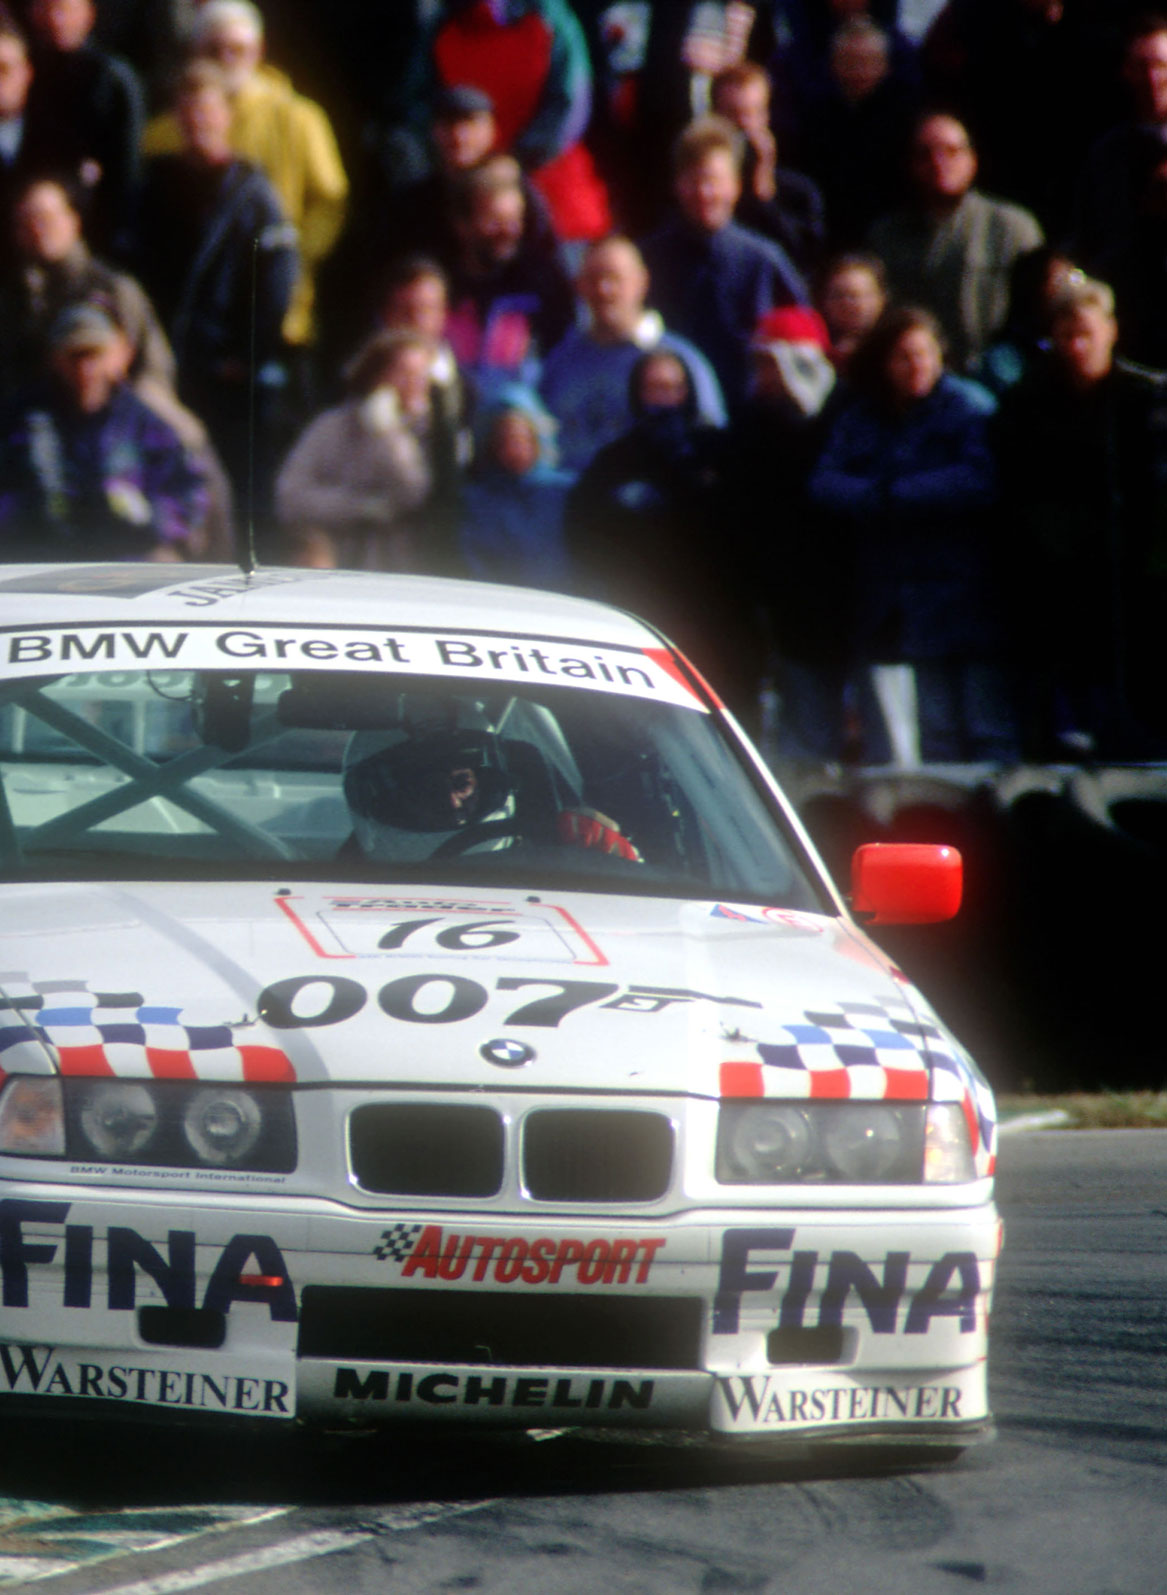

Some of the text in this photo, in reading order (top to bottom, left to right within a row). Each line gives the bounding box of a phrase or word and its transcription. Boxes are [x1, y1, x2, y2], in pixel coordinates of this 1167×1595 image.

[8, 630, 655, 689] BMW Great Britain
[377, 917, 521, 950] 16
[257, 974, 618, 1028] 007
[70, 1166, 287, 1184] BMW Motorsport International
[401, 1225, 666, 1285] AUTOSPORT
[713, 1228, 981, 1334] FINA
[334, 1368, 654, 1409] MICHELIN
[715, 1376, 963, 1424] WARSTEINER
